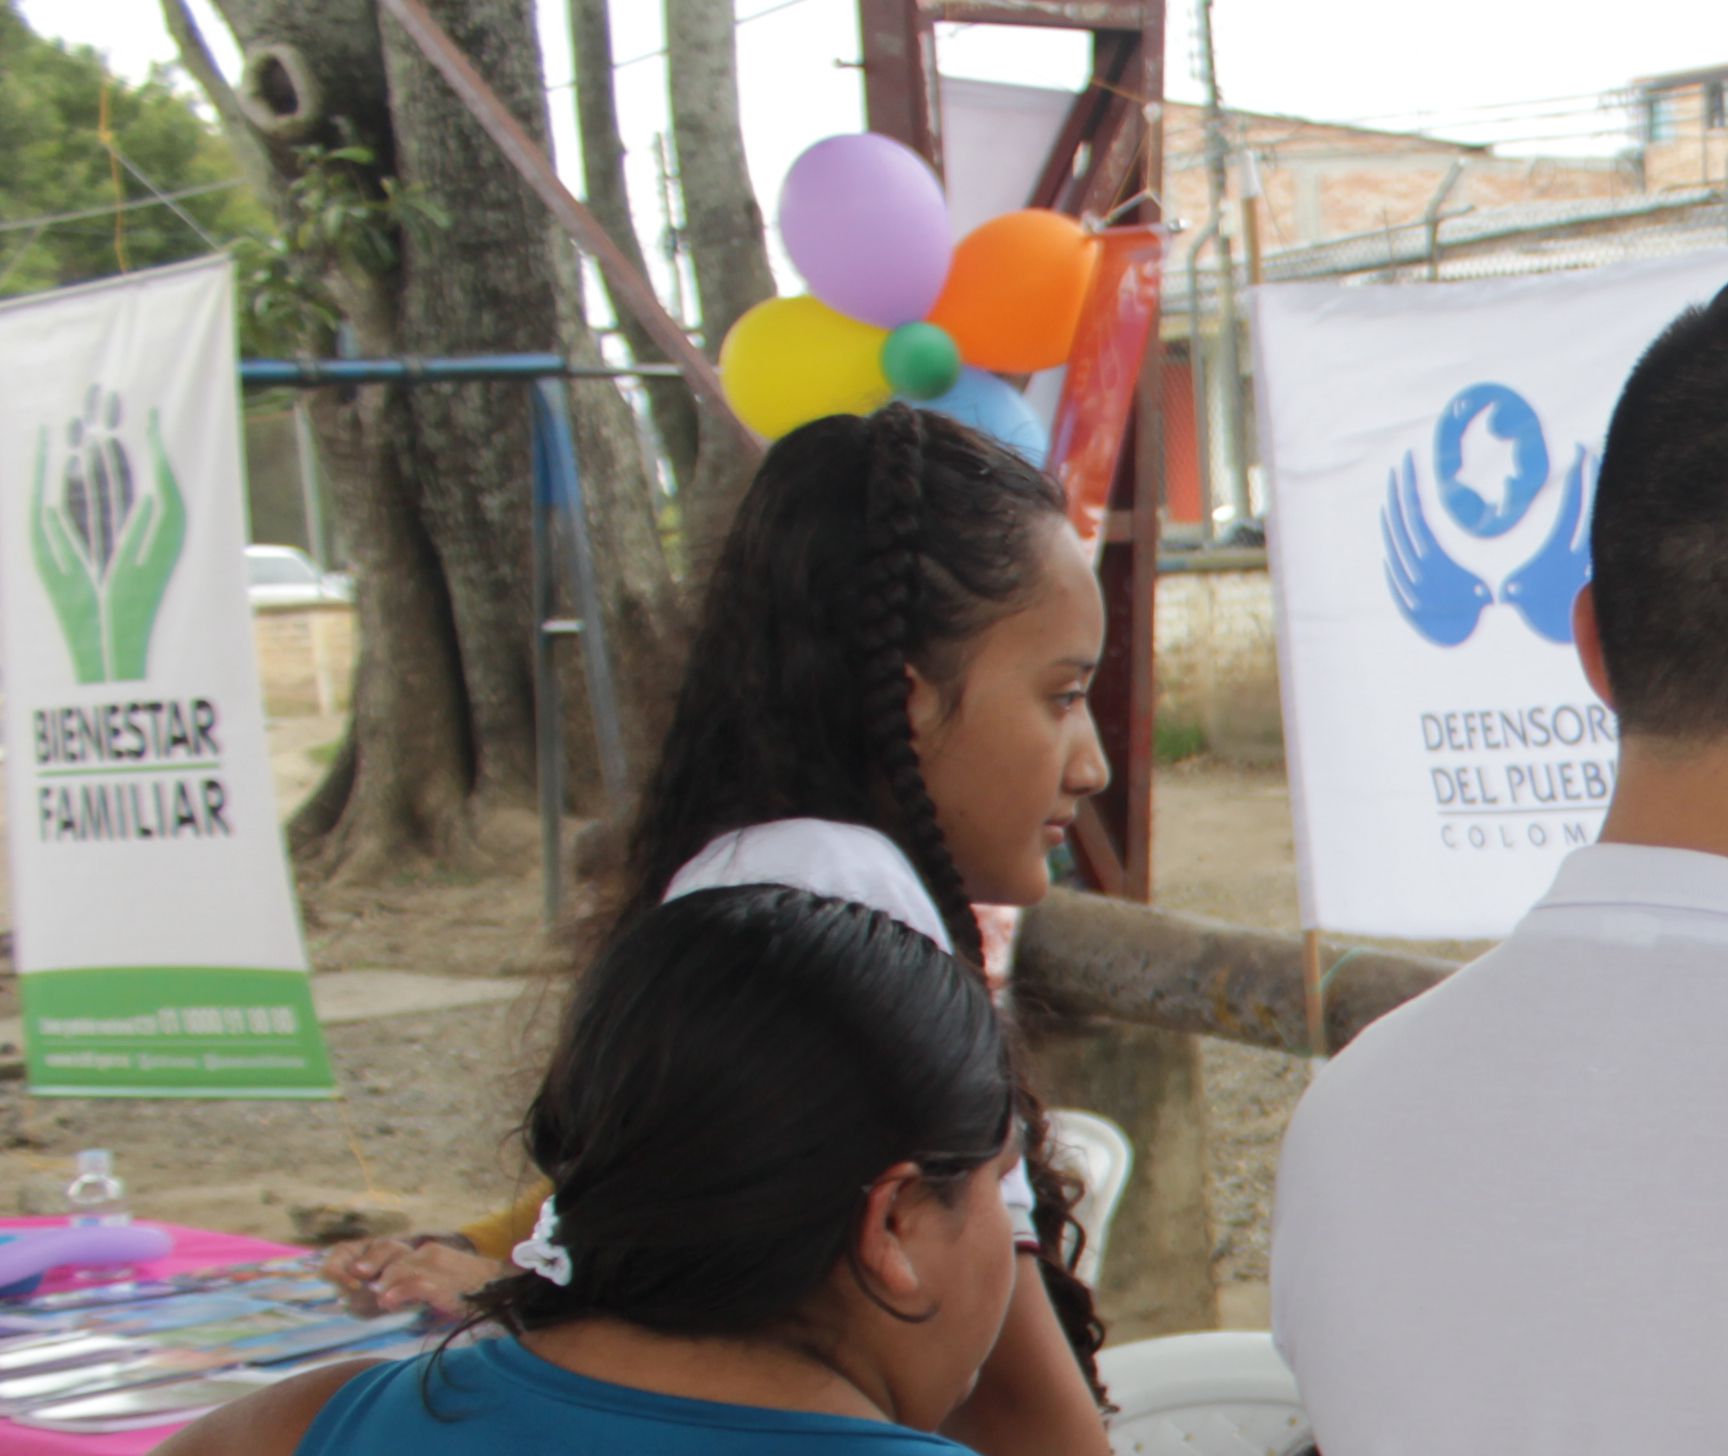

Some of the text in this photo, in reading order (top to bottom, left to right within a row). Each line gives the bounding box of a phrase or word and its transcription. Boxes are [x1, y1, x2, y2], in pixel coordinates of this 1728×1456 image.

[34, 699, 219, 766] BIENESTAR
[1421, 703, 1615, 751] DEFENSOR
[39, 776, 232, 842] FAMILIAR
[1431, 766, 1498, 805] DEL
[1441, 823, 1588, 848] COLOM
